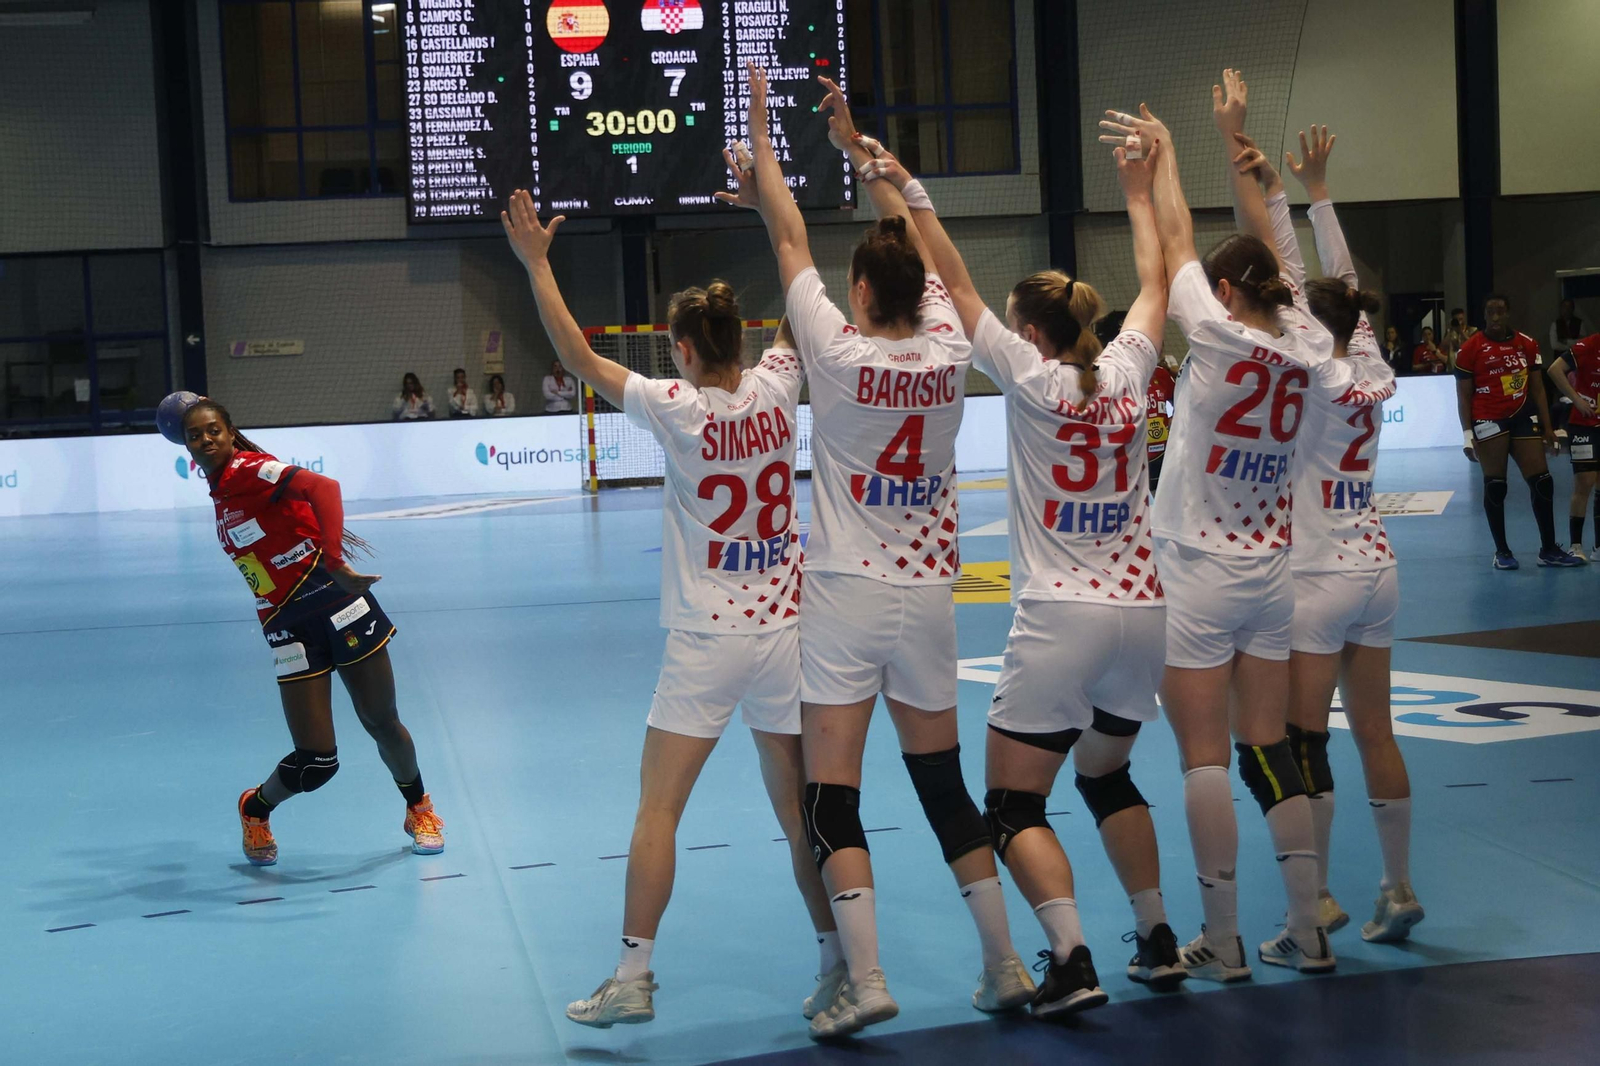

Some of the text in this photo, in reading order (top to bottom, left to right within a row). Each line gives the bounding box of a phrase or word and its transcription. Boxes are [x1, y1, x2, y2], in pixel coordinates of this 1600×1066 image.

[722, 2, 728, 14] 2
[734, 0, 777, 15] KRAGULJ
[779, 0, 789, 12] N.
[407, 9, 530, 23] 6 CAMPOS C. 1
[723, 13, 843, 27] 3 POSAVEC P. 0
[405, 22, 531, 37] 14 VEGEUE O. 0
[723, 27, 844, 41] 4 BARISIC T. 2
[406, 39, 417, 51] 16
[421, 37, 488, 51] CASTELLANOS
[526, 36, 532, 47] 0
[724, 40, 844, 56] 5 ZRILIC I. 0
[407, 52, 417, 64] 17
[477, 51, 485, 63] J.
[528, 50, 532, 60] 1
[651, 50, 697, 64] CROACIA
[725, 57, 730, 68] 7
[772, 55, 781, 66] K.
[840, 54, 844, 64] 1
[407, 63, 534, 78] 19 SOMAZA E. 0
[722, 70, 734, 82] 10
[840, 67, 845, 78] 2
[407, 77, 534, 92] 23 ARCOS P. 2
[570, 71, 592, 100] 9
[664, 69, 686, 96] 7
[724, 84, 734, 95] 17
[409, 91, 535, 106] 27 SO DELGADO D. 2
[724, 97, 736, 109] 23
[787, 96, 797, 107] K.
[409, 104, 536, 120] 33 GASSAMA K. 0
[554, 107, 570, 115] TM
[690, 102, 705, 111] TM
[586, 109, 677, 136] 30:00
[724, 111, 737, 123] 25
[773, 110, 780, 121] L.
[409, 122, 422, 133] 34
[483, 119, 493, 130] A.
[531, 118, 536, 129] 2
[725, 125, 737, 136] 26
[773, 123, 784, 134] M.
[411, 136, 423, 147] 52
[459, 134, 468, 145] P.
[531, 132, 537, 142] 0
[780, 136, 790, 148] A.
[411, 146, 538, 161] 53 MBENGUE S. 0
[612, 143, 652, 154] PERIODO
[783, 150, 792, 161] A.
[412, 160, 539, 174] 58 PRIETO M. 0
[626, 156, 637, 173] 1
[843, 162, 849, 172] 0
[412, 177, 426, 188] 65
[428, 174, 478, 188] ERAUSKIN
[480, 175, 489, 186] A.
[799, 176, 807, 187] P.
[844, 176, 850, 185] 0
[533, 187, 540, 195] 0
[415, 206, 426, 217] 70
[430, 204, 470, 216] ARROYO
[473, 204, 483, 214] C.
[888, 353, 922, 362] CROATIA
[1503, 355, 1518, 367] 33
[1489, 367, 1504, 375] AVIS
[1214, 360, 1309, 443] 26
[702, 406, 791, 461] ŠIMARA
[1339, 405, 1375, 471] 2
[876, 415, 925, 483] 4
[1051, 423, 1136, 492] 31
[1240, 452, 1288, 484] HEP
[887, 475, 941, 507] HEP
[698, 461, 792, 541] 28
[1078, 502, 1130, 533] HEP
[745, 529, 790, 571] HEP
